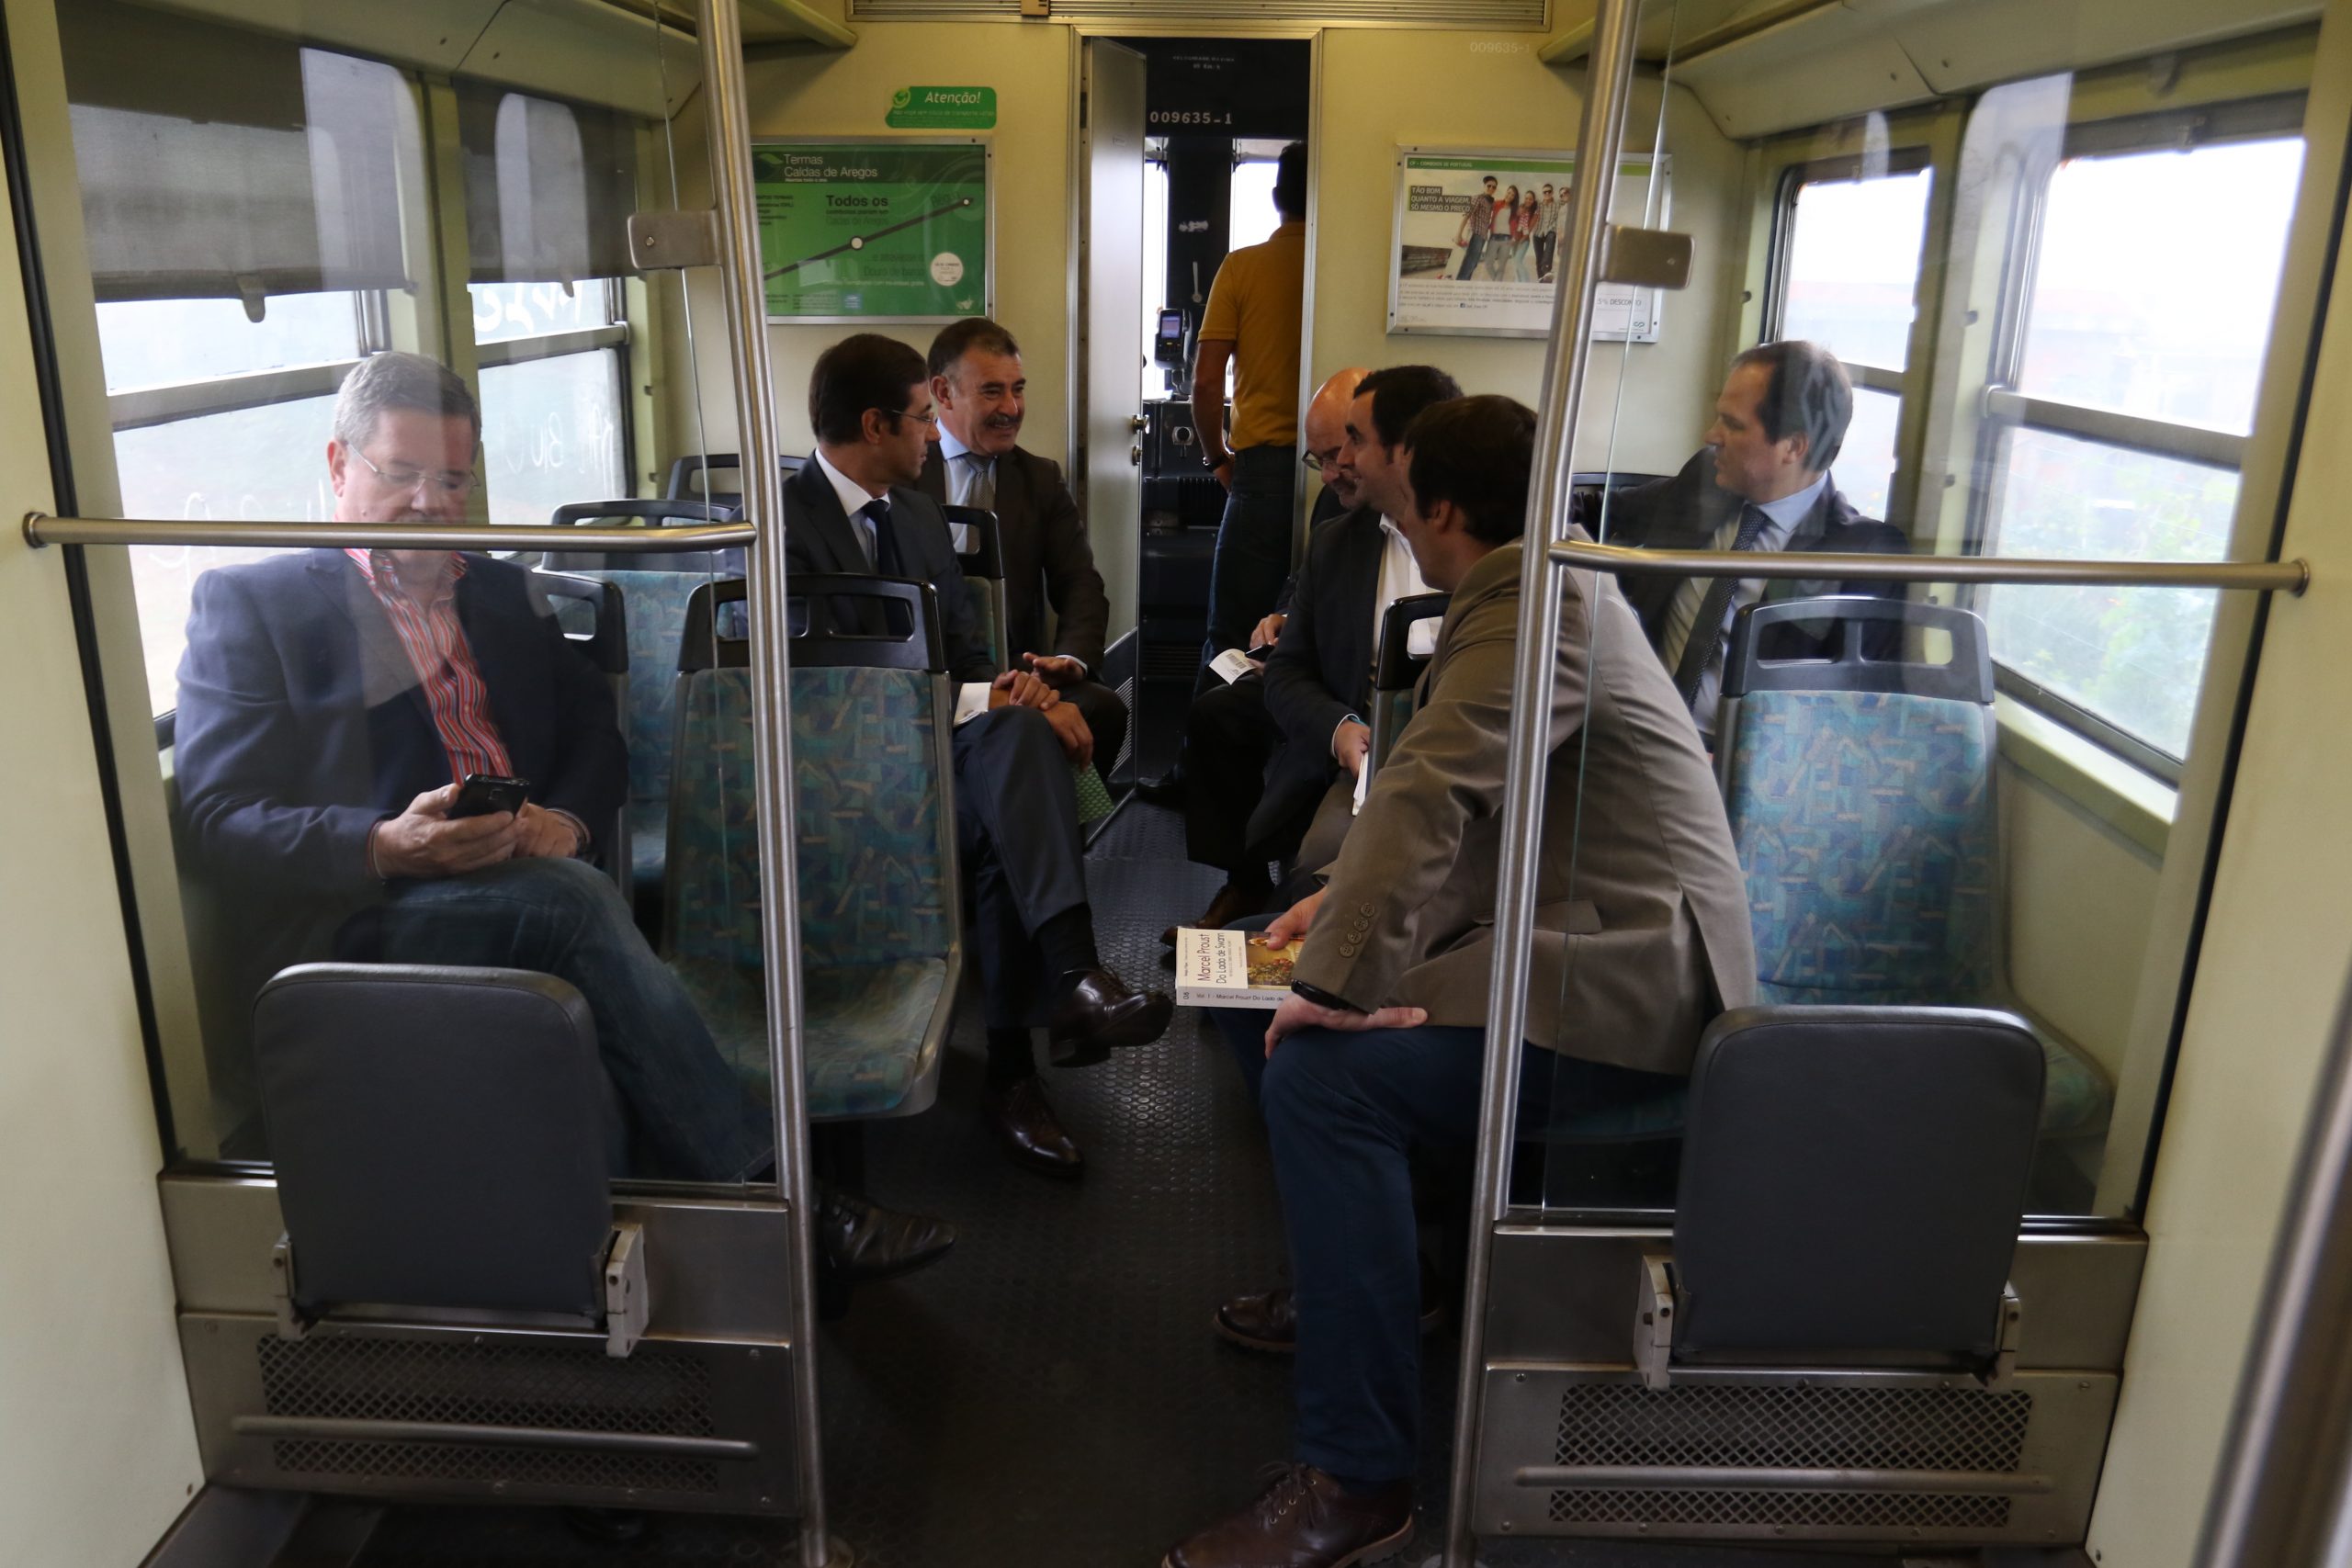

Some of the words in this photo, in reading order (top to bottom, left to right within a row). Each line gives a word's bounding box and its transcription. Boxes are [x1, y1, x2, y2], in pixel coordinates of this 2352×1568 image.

[924, 91, 981, 107] Atenção!
[1150, 111, 1232, 124] 009635-1
[783, 154, 823, 165] Termas
[784, 166, 820, 177] Caldas
[824, 166, 837, 177] de
[840, 167, 878, 180] Aregos
[825, 195, 868, 206] Todos
[872, 197, 888, 206] os
[1197, 934, 1210, 954] Proust
[1215, 933, 1225, 948] Swann
[1197, 954, 1211, 981] Marcel
[1216, 958, 1227, 973] Lado
[1216, 975, 1227, 983] Do
